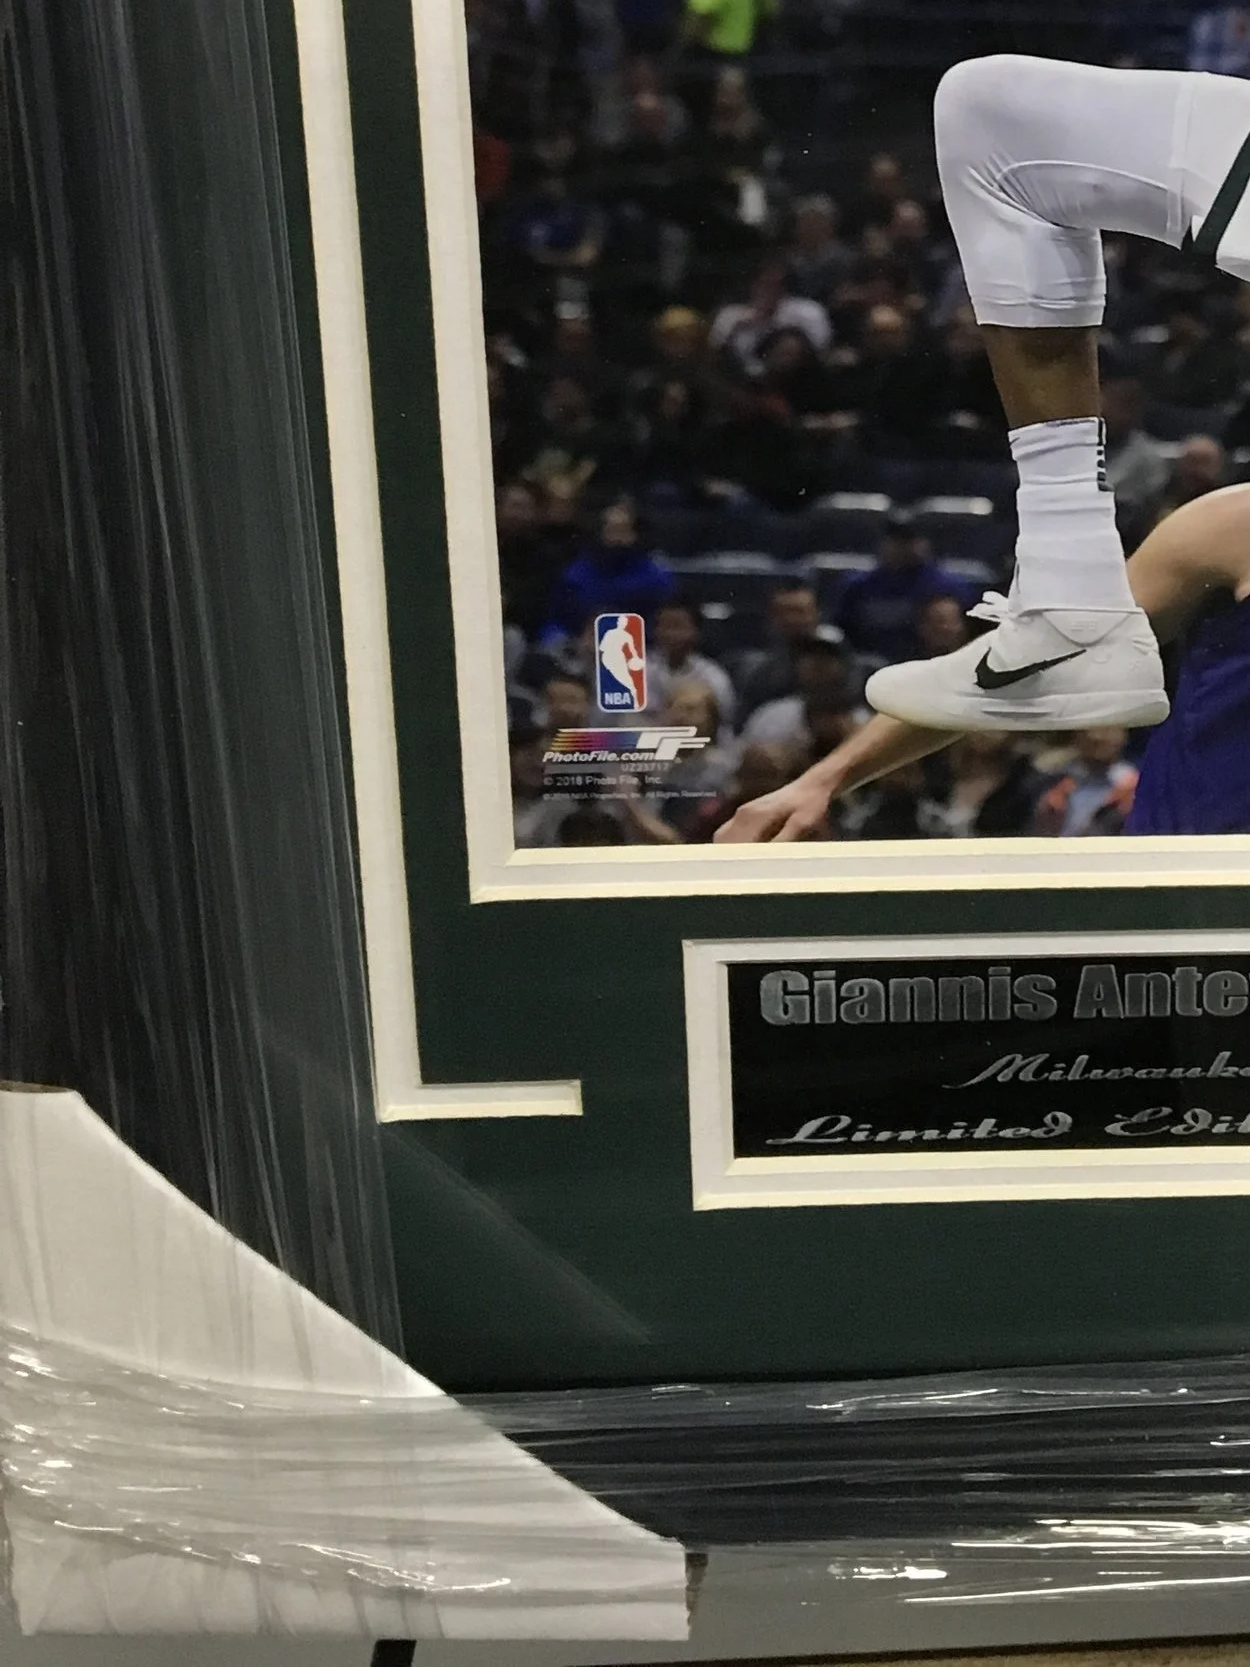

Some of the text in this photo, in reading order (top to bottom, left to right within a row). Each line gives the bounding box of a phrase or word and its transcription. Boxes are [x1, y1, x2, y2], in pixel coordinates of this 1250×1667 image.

[604, 692, 631, 706] NBA
[542, 750, 655, 763] PhotoFile.com
[760, 966, 1058, 1026] Giannis
[766, 1110, 1074, 1145] Limited
